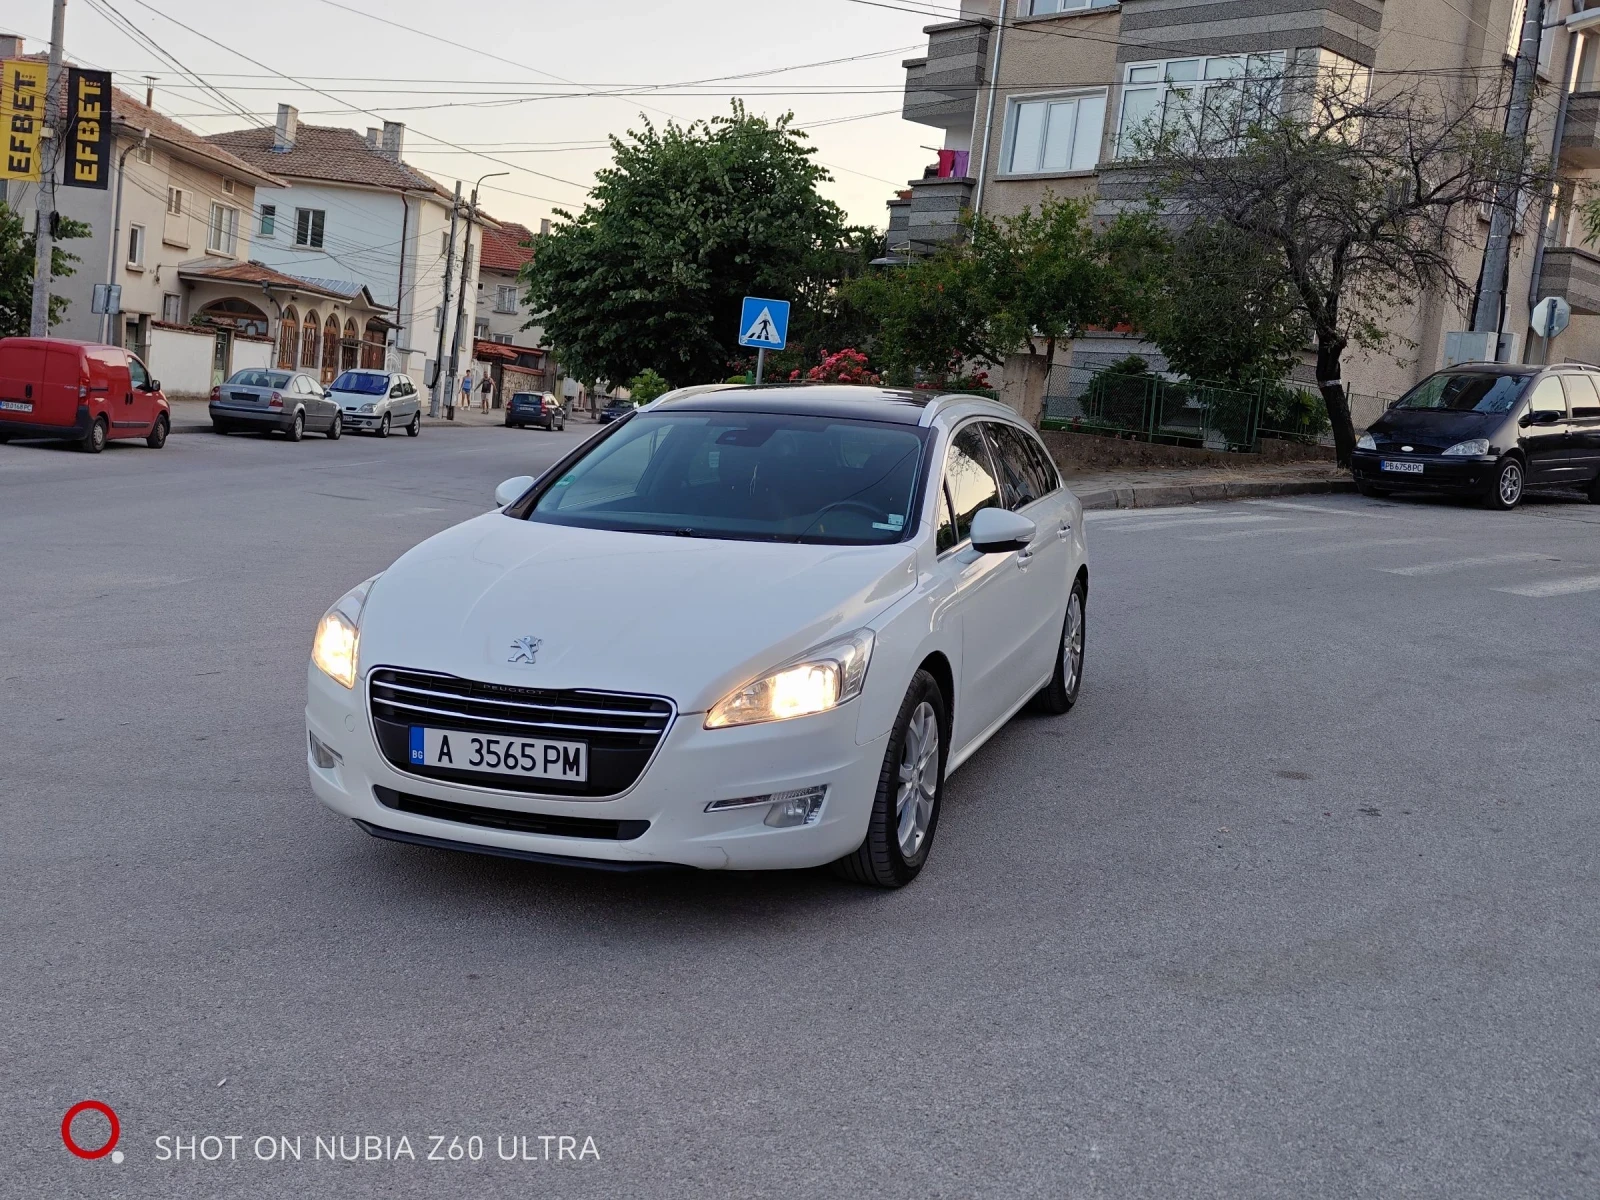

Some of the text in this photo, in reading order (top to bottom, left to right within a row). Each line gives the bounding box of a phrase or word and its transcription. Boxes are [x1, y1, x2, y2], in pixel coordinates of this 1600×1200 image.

[8, 70, 36, 173] EFBET
[75, 76, 101, 181] EFBET
[483, 684, 545, 695] PEUGEOT
[412, 750, 423, 759] BG
[437, 735, 453, 764] A
